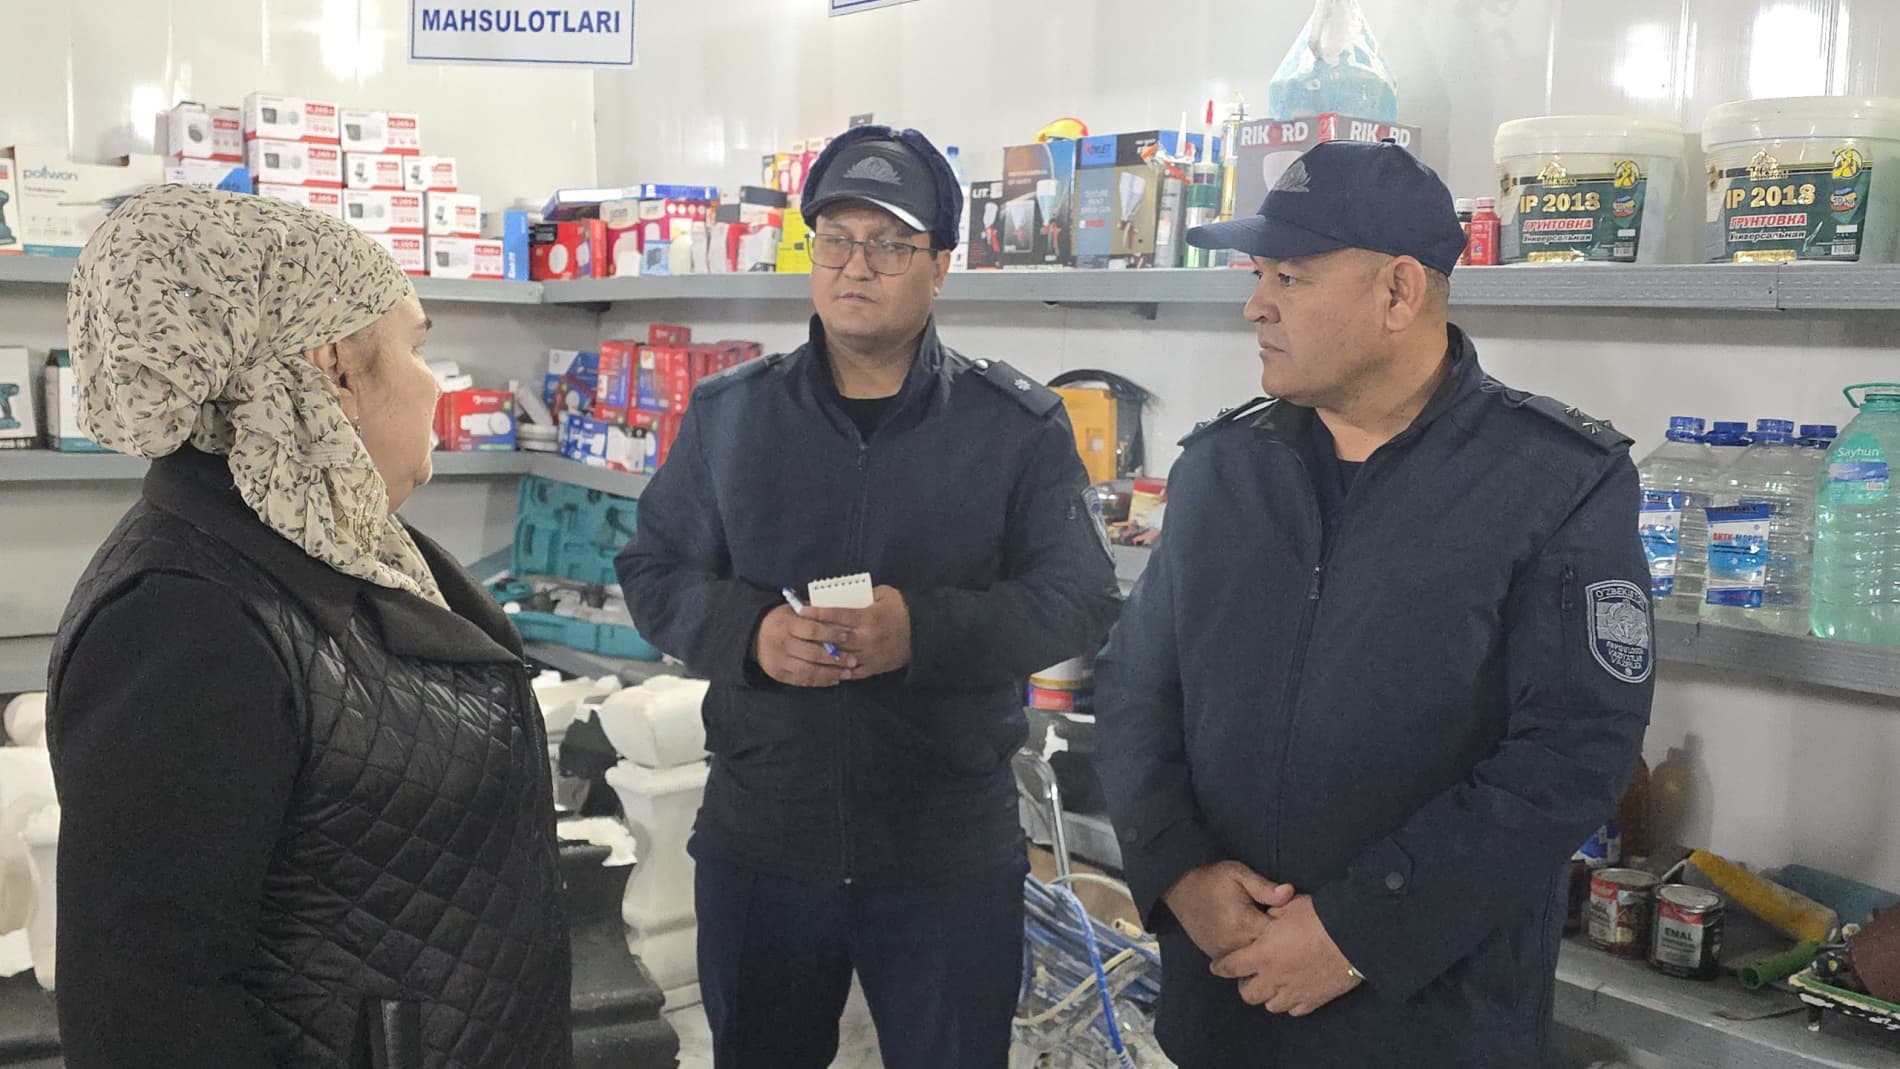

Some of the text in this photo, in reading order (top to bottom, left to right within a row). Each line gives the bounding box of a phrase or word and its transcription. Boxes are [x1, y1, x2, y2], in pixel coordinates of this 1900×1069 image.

[421, 8, 621, 34] MAHSULOTLARI
[1542, 191, 1600, 213] 2018
[1750, 183, 1816, 208] 2018
[1523, 219, 1593, 231] ГРУНТОВКА
[1730, 213, 1806, 228] ГРУНТОВКА
[1838, 447, 1880, 457] Sayhun
